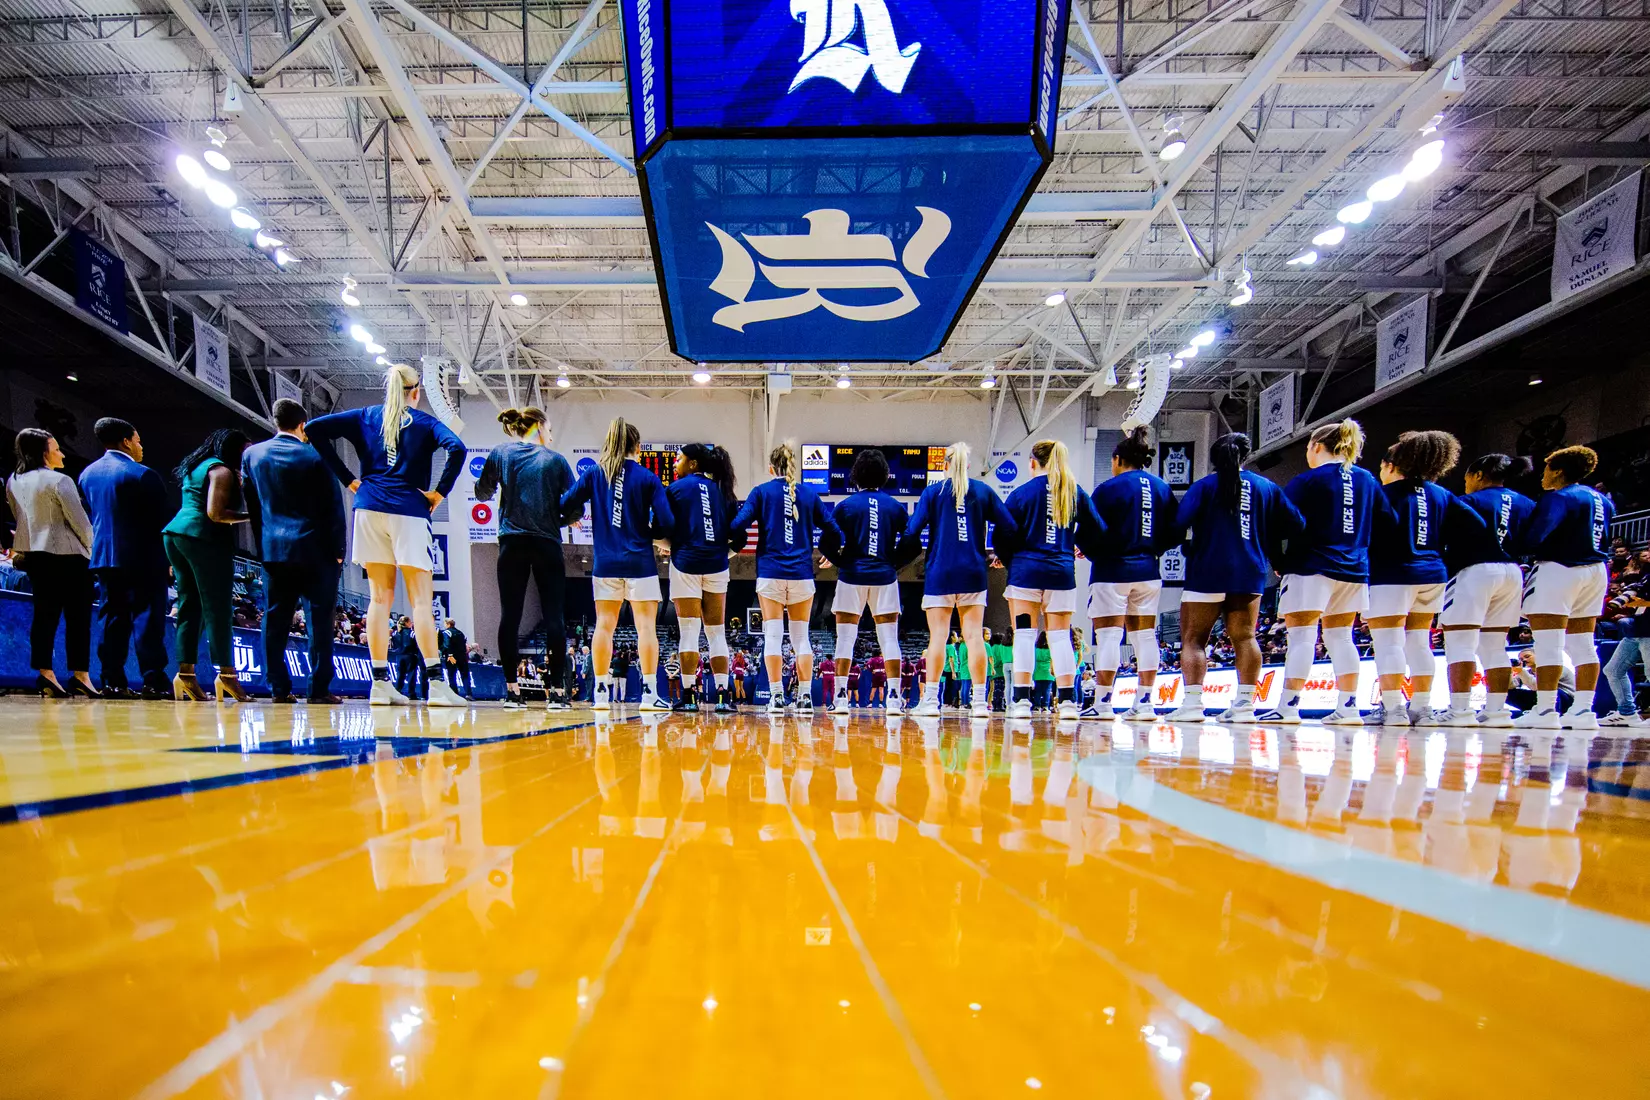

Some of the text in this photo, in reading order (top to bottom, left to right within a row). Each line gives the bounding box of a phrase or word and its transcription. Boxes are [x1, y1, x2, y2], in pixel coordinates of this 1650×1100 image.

[1571, 238, 1611, 267] RICE
[1568, 260, 1608, 283] SAMUEL
[1570, 267, 1609, 290] DUNLAP
[89, 281, 112, 306] RICE
[1388, 344, 1411, 364] RICE
[903, 448, 921, 456] TAMU
[997, 467, 1016, 475] NCAA
[1168, 461, 1185, 475] 29
[612, 501, 623, 528] RICE
[698, 482, 715, 542] RICE OWLS
[782, 485, 794, 545] RICE OWLS
[1139, 477, 1152, 538] RICE OWLS
[1240, 479, 1251, 540] RICE OWLS
[1341, 472, 1355, 534] RICE OWLS
[1414, 486, 1428, 546] RICE OWLS
[1499, 493, 1512, 527] OWLS
[868, 497, 879, 557] RICE OWLS
[957, 515, 968, 542] RICE
[1164, 558, 1181, 571] 32
